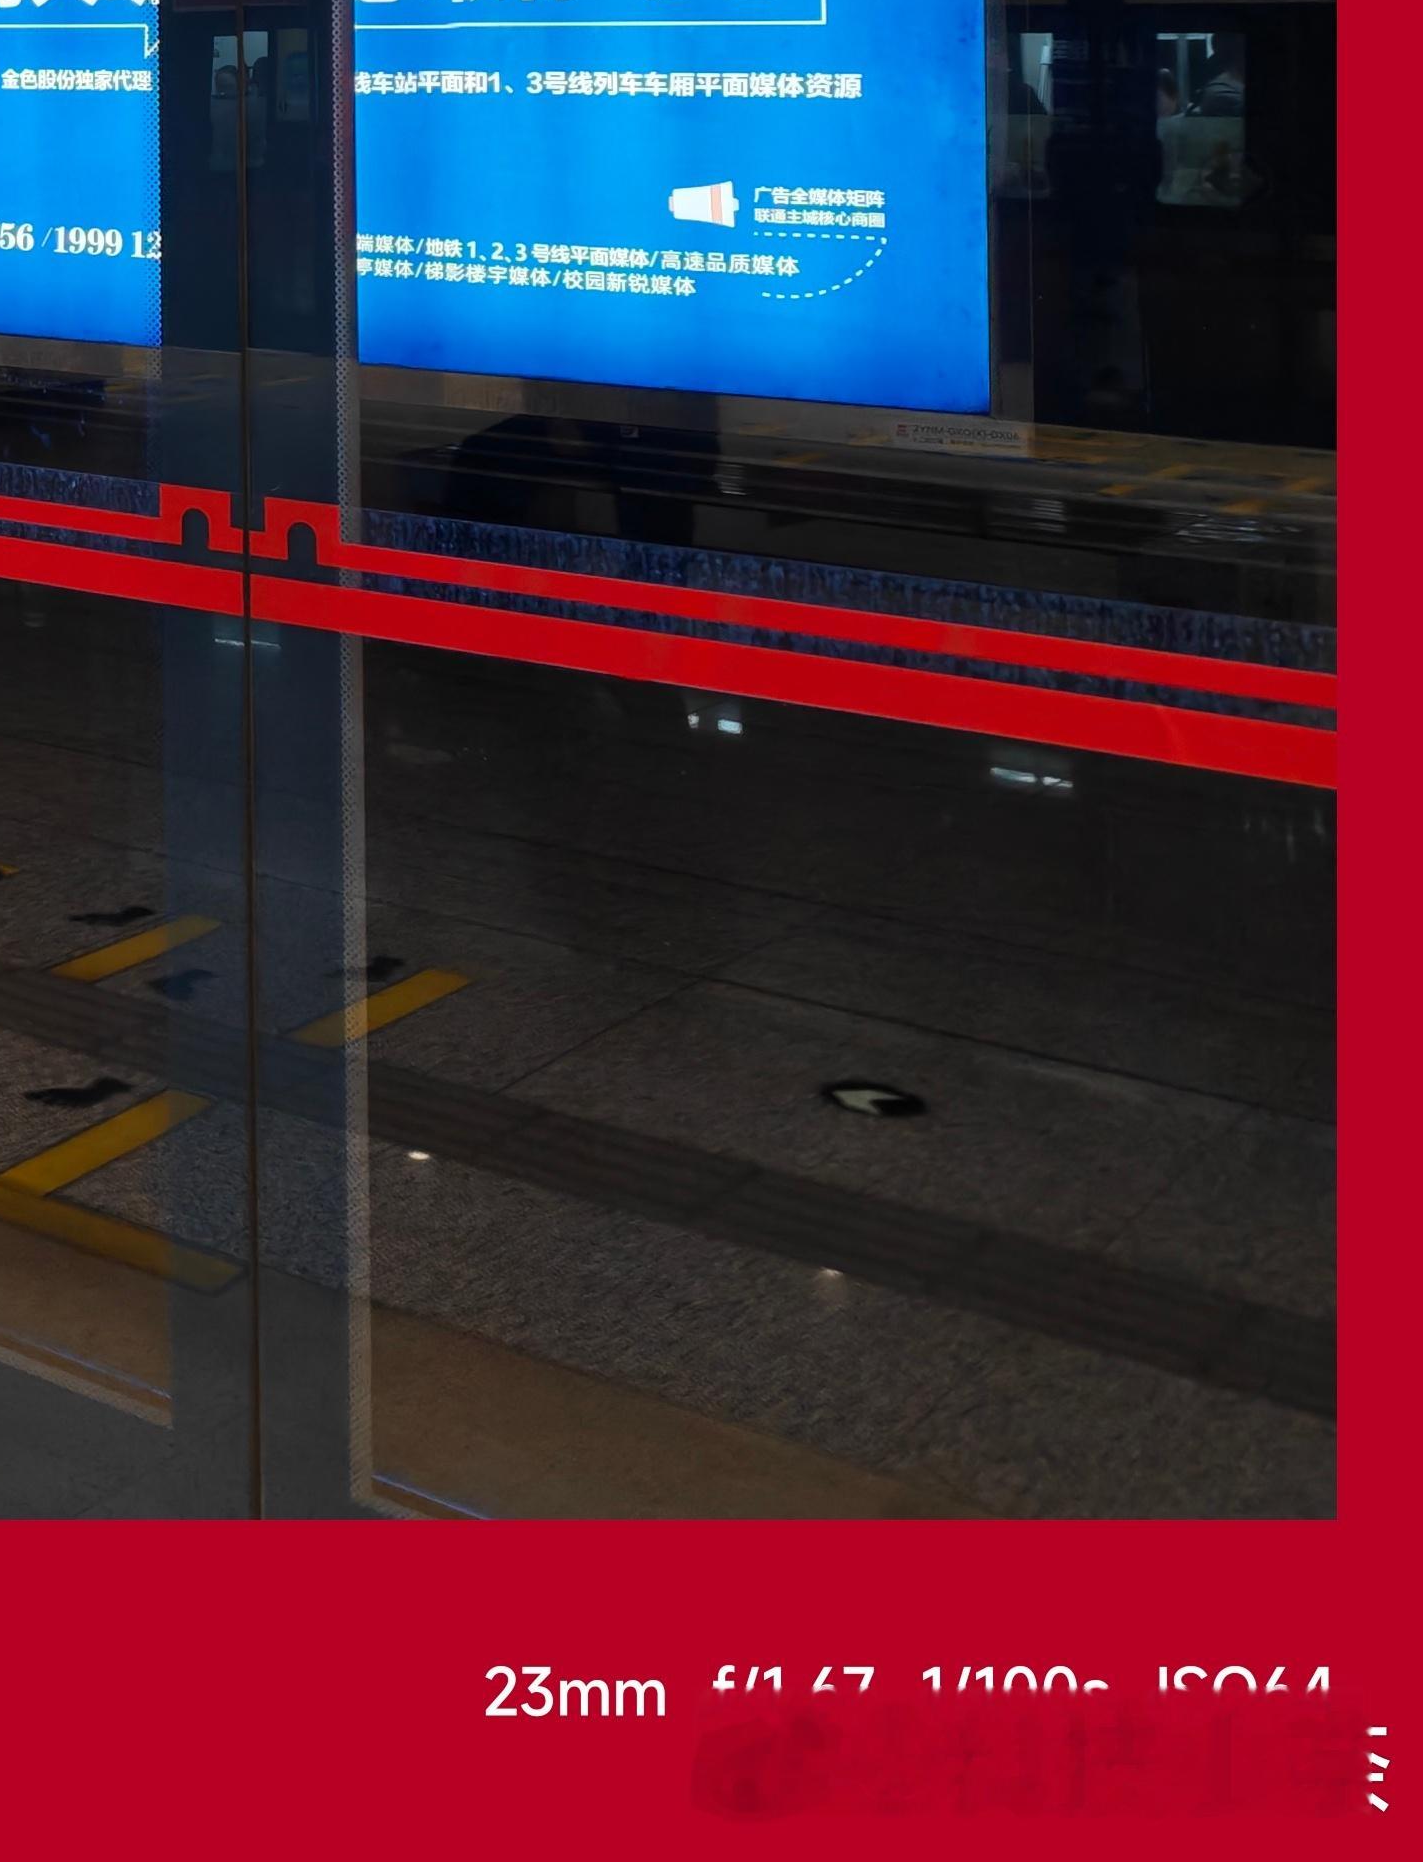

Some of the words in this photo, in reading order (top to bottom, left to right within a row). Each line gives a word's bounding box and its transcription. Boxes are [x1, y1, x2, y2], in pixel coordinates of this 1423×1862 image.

[0, 67, 154, 93] 金色股份独家代理
[753, 185, 886, 209] 广告全媒体矩阵
